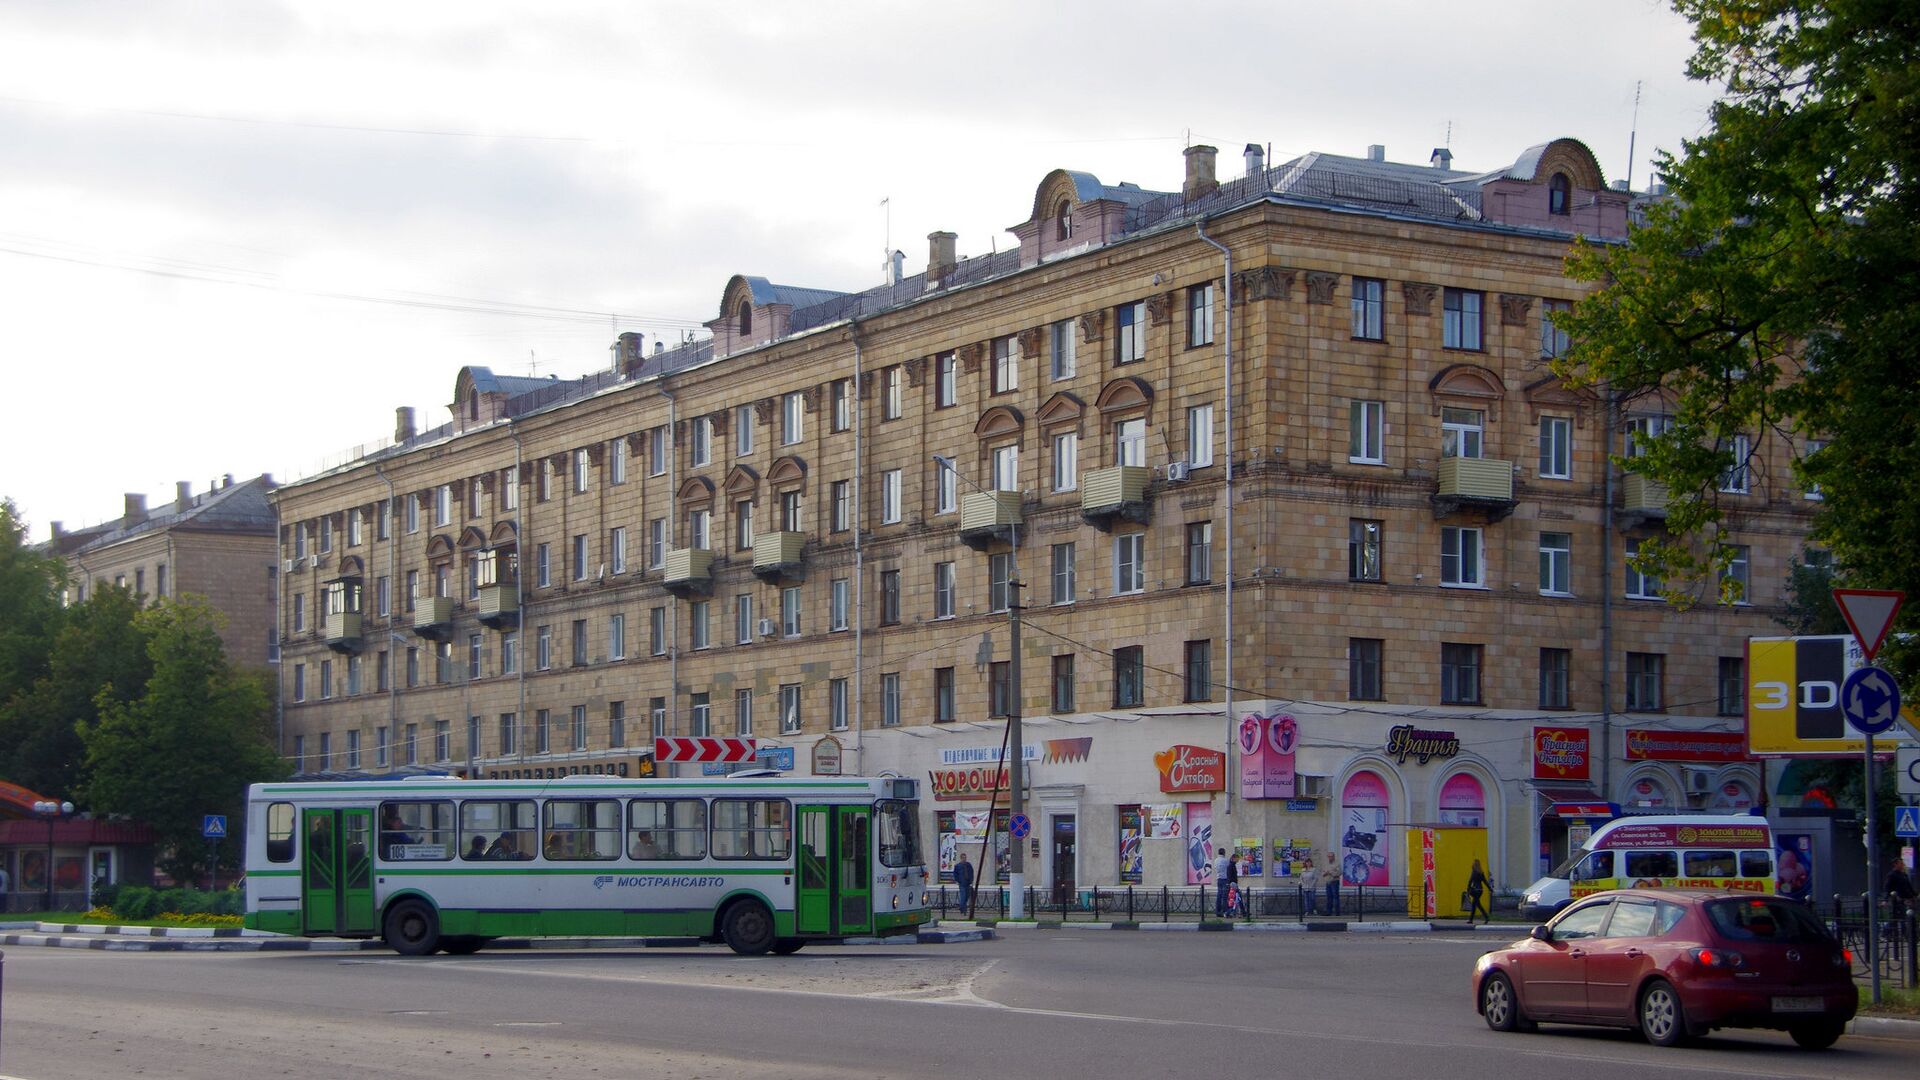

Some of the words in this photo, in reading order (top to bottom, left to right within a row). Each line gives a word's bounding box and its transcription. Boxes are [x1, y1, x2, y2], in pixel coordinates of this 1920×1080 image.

[1388, 726, 1459, 763] Грация
[1543, 736, 1586, 752] Красный
[944, 748, 987, 763] ОТДЕЛОЧНЫЕ
[1173, 747, 1219, 770] Красный
[1538, 751, 1584, 767] Октябрь
[1170, 764, 1215, 788] Октябрь
[1423, 830, 1435, 915] КВАС
[617, 877, 724, 888] МОСТРАНСАВТО
